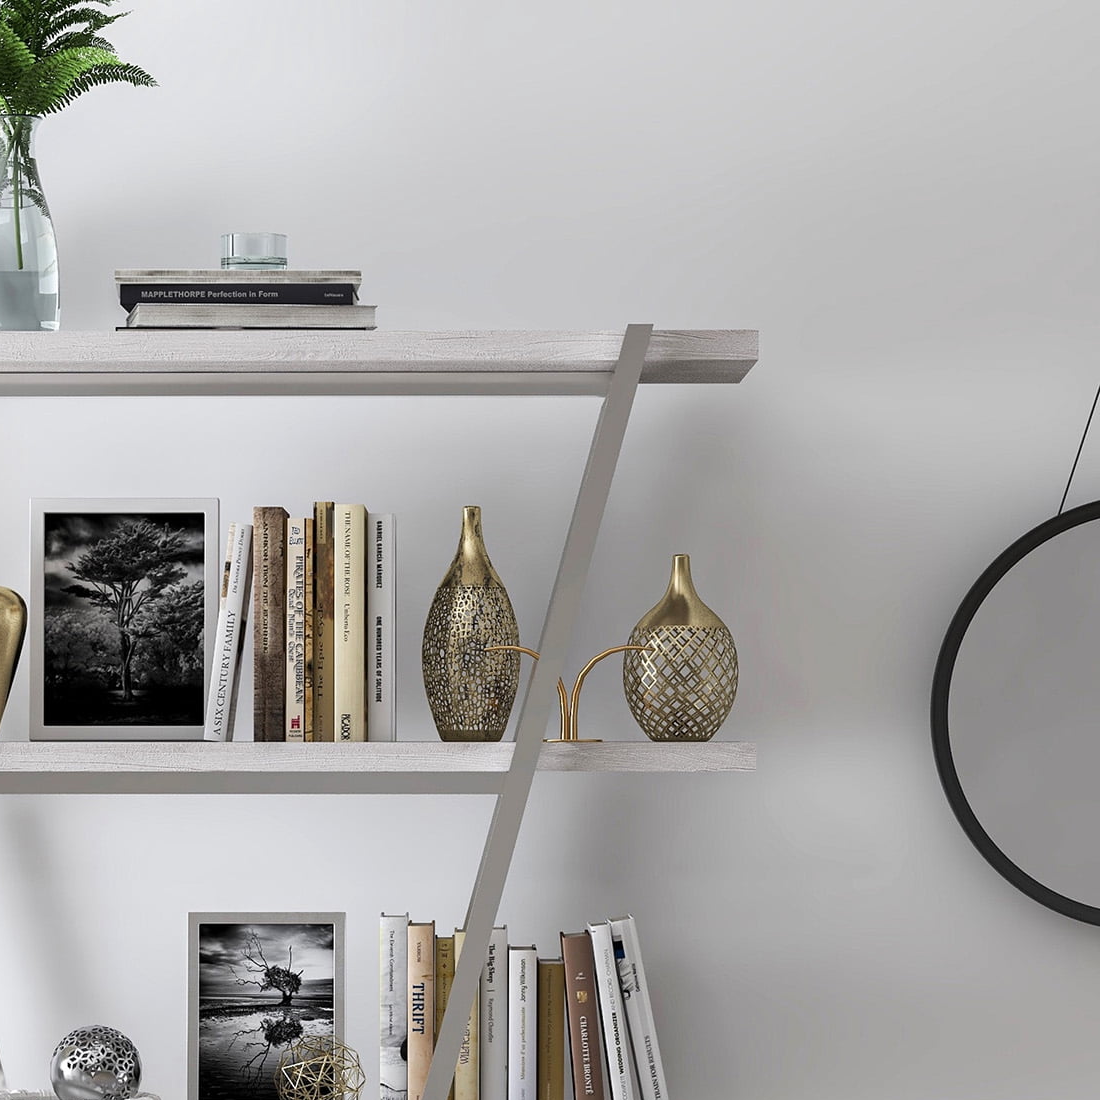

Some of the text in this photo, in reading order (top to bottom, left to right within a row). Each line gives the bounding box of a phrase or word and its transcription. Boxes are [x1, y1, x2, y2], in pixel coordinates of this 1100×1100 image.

[140, 290, 279, 299] MAPPLETHORPE Perfection in Form
[344, 511, 352, 526] THE
[344, 526, 352, 550] NAME
[293, 555, 304, 600] PIRATES
[344, 560, 352, 575] THE
[344, 575, 352, 597] ROSE
[294, 600, 304, 618] OF
[295, 620, 304, 642] THE
[213, 609, 237, 736] A SIX CENTURY FAMILY
[316, 676, 324, 701] The
[340, 713, 351, 741] PICADOR
[487, 943, 496, 984] The Big Sleep
[519, 985, 528, 1003] Jonny
[412, 982, 425, 1036] THRIFT
[580, 1015, 590, 1064] CHARLOTTE
[612, 1012, 621, 1046] ORGANIZER
[616, 1046, 625, 1075] WEDDING
[644, 1034, 655, 1063] RESULTS
[649, 1063, 657, 1078] FOR
